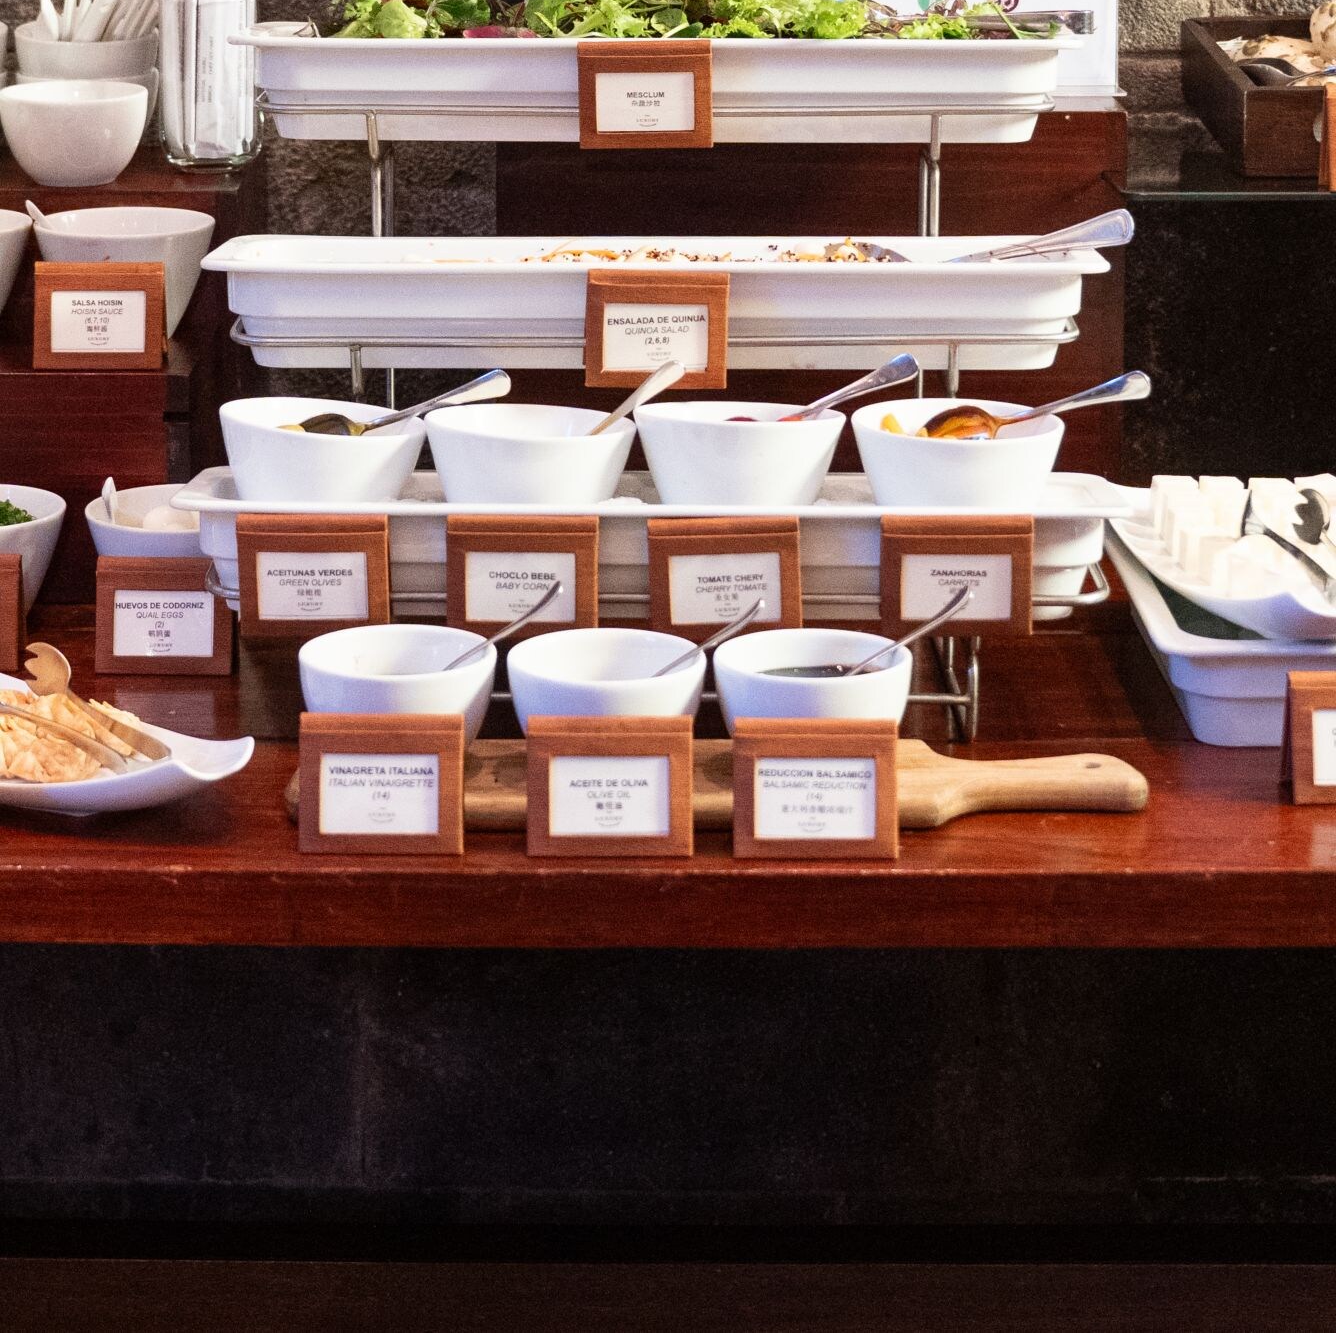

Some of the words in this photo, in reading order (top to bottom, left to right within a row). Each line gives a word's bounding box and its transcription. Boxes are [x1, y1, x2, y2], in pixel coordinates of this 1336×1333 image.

[607, 317, 655, 326] ENSALADA
[657, 316, 669, 324] DE
[671, 315, 706, 323] QUINUA
[624, 327, 659, 335] QUINOA
[661, 325, 690, 333] SALAD
[267, 569, 316, 577] ACEITUNAS
[488, 571, 529, 580] CHOCLO
[531, 572, 557, 580] BEBE
[930, 569, 988, 577] ZANAHORIAS
[311, 578, 342, 586] OLIVES
[697, 575, 732, 583] TOMATE
[734, 574, 764, 582] CHERY
[495, 582, 521, 590] BABY
[523, 582, 550, 591] CORN
[696, 585, 732, 593] CHERRY
[136, 611, 159, 619] QUAIL
[161, 611, 184, 619] EGGS
[155, 621, 165, 629] (2)
[329, 766, 386, 775] VINAGRETA
[388, 766, 434, 775] ITALIANA
[758, 769, 814, 777] REDUCCION
[816, 770, 872, 778] BALSAMICO
[329, 778, 367, 787] ITALIAN
[369, 778, 434, 787] VINAIGRETTE
[569, 779, 603, 787] ACEITE
[605, 779, 618, 787] DE
[620, 779, 649, 787] OLIVA
[763, 780, 809, 788] BALSAMIC
[812, 781, 867, 790] REDUCTION
[587, 790, 614, 798] OLIVE
[616, 790, 631, 798] OIL
